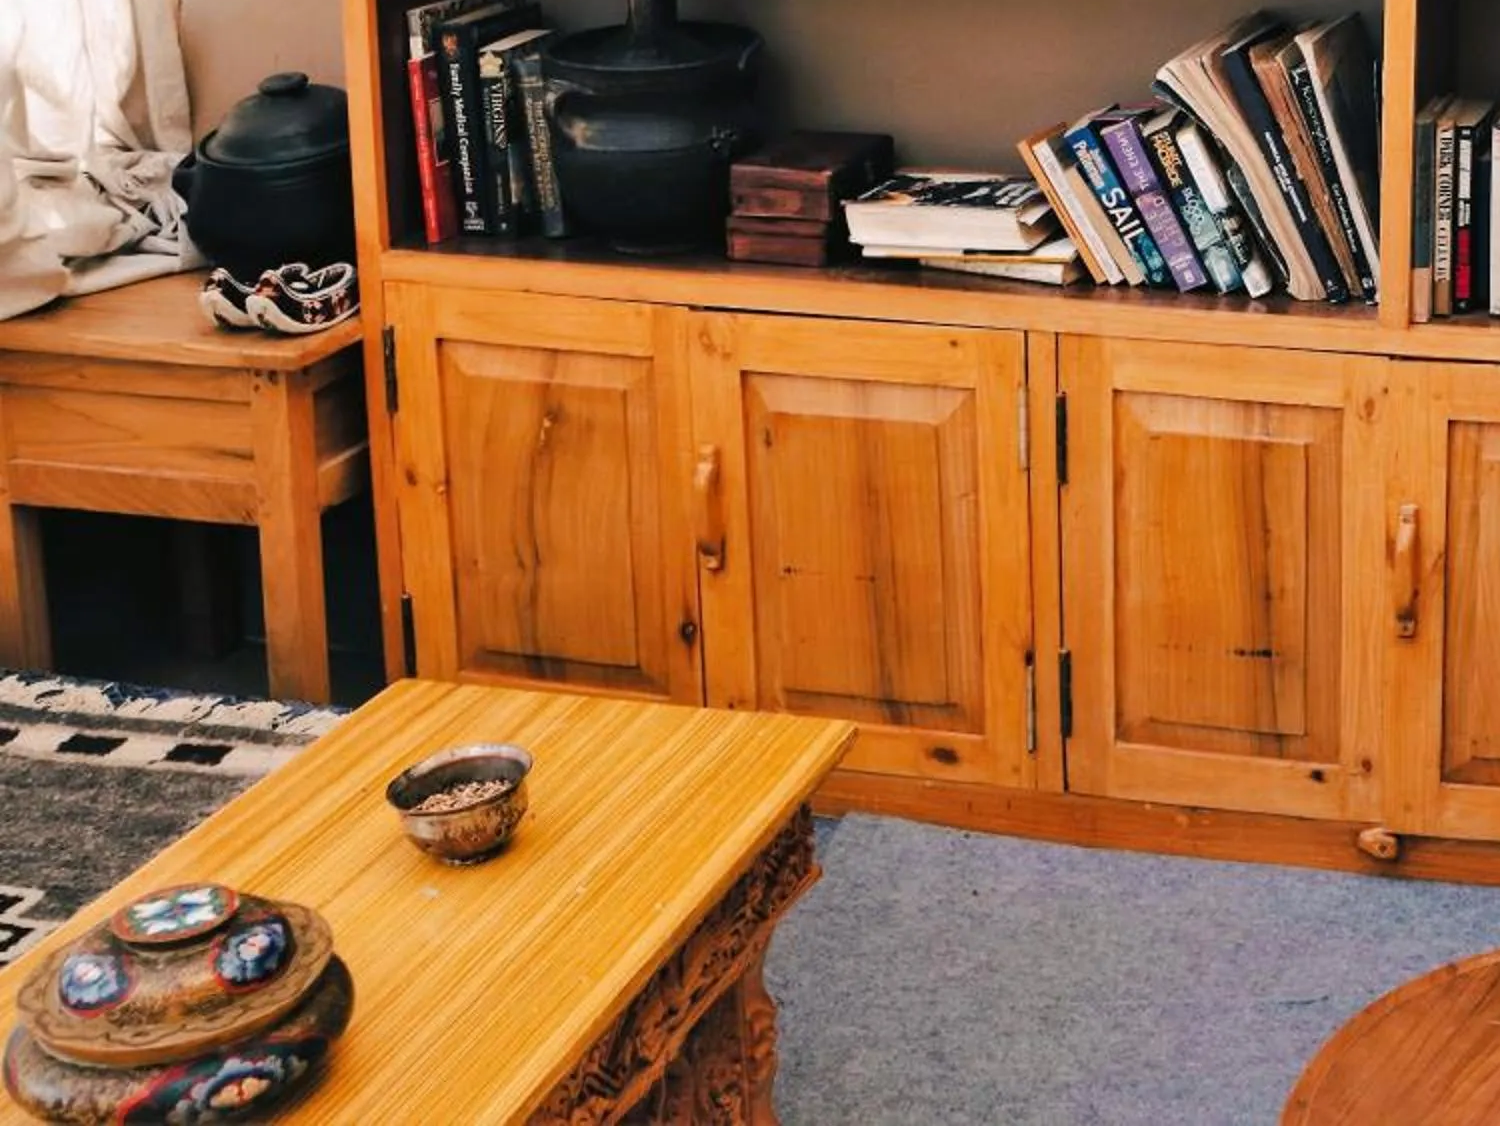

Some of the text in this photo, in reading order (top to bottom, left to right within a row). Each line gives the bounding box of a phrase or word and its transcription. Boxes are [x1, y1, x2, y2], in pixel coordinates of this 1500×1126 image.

[448, 62, 463, 97] Family
[453, 97, 469, 137] Medical
[1117, 129, 1151, 192] THE ENEMY
[1438, 136, 1454, 170] DARK
[1099, 186, 1147, 251] SAIL
[1436, 172, 1453, 222] CORNER
